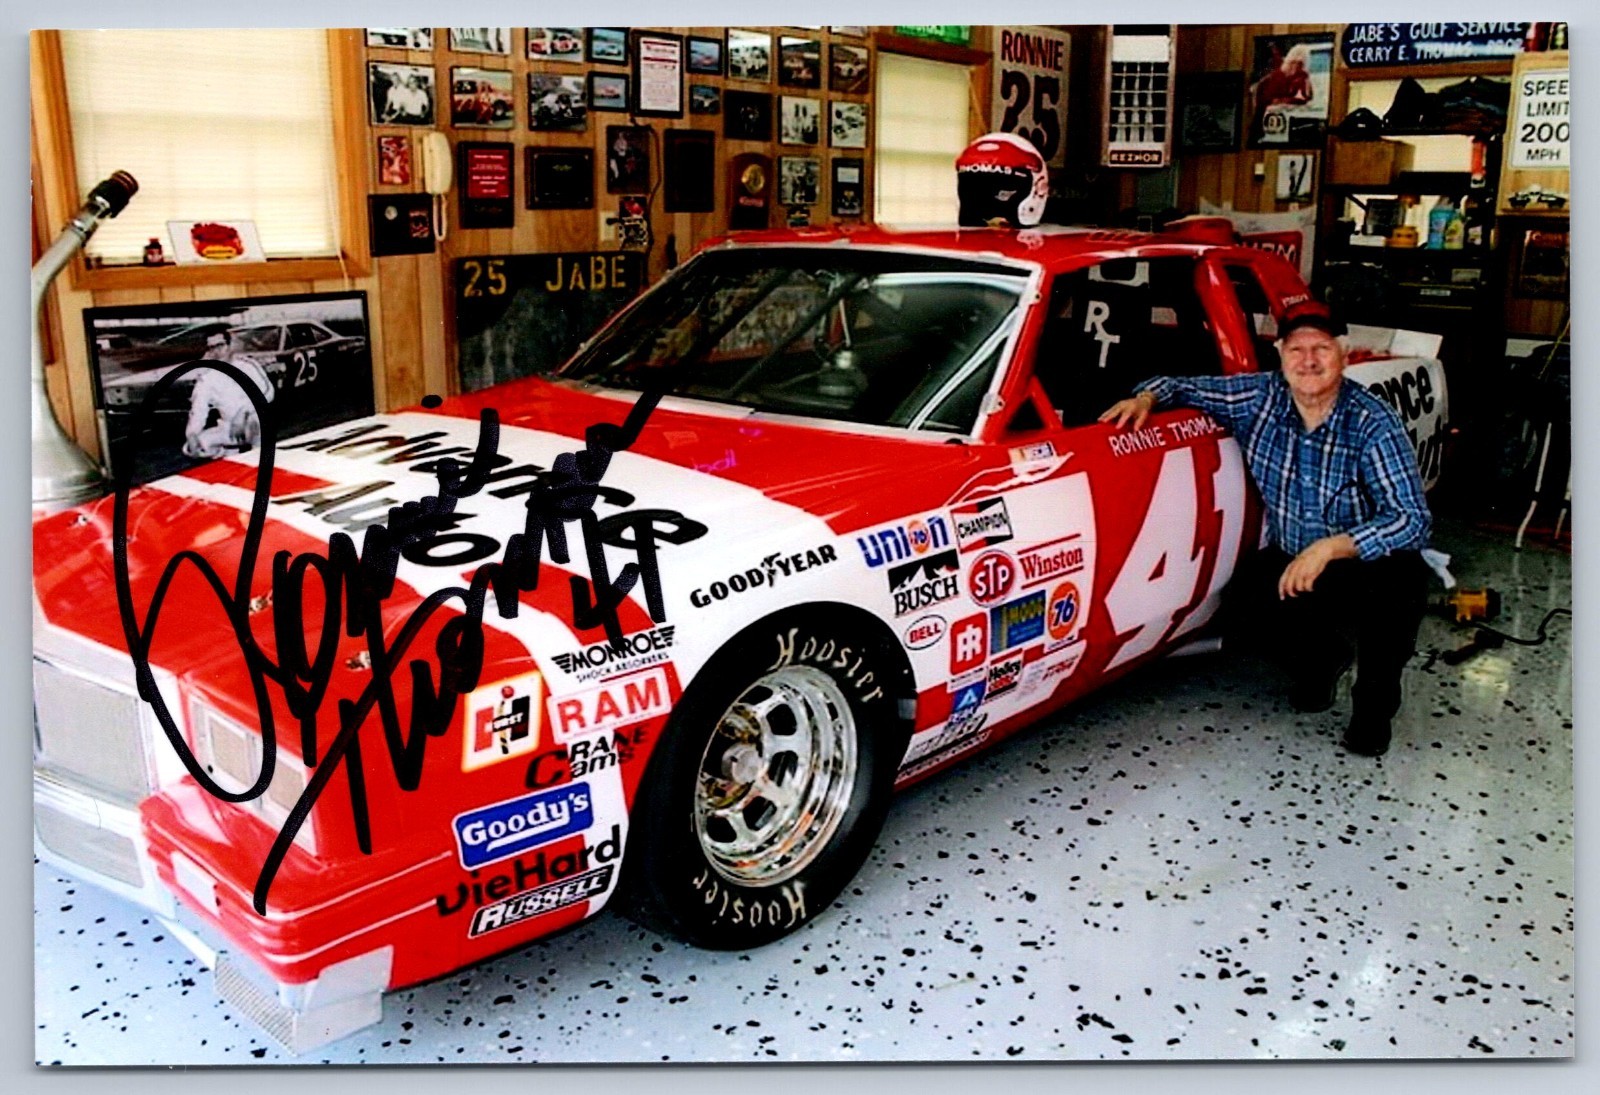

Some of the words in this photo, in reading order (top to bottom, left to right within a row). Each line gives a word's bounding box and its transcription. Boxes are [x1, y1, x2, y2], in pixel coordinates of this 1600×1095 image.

[1001, 29, 1064, 72] RONNIE
[1350, 23, 1400, 43] JABE'S
[1410, 22, 1449, 40] GULF
[1001, 68, 1060, 162] 25
[1527, 101, 1569, 117] LIMIT
[1521, 122, 1569, 143] 200
[1526, 149, 1560, 160] MPH
[464, 260, 506, 297] 25
[545, 254, 626, 292] JABE
[294, 350, 318, 387] 25
[1108, 426, 1166, 457] RONNIE
[1167, 416, 1224, 442] THOMA
[957, 512, 1008, 539] CHAMPION
[1020, 548, 1083, 582] Winston
[1103, 437, 1246, 672] 41
[690, 544, 837, 608] GOODYEAR
[893, 575, 960, 618] BUSCH
[974, 558, 1010, 598] STP
[1054, 593, 1076, 627] 76
[571, 630, 666, 672] MONROE
[910, 623, 942, 643] BELL
[576, 667, 612, 682] SHOCK
[615, 652, 670, 672] ABSORBERS
[767, 627, 884, 702] Hoosier
[558, 677, 661, 733] RAM
[462, 793, 590, 848] Goody's
[692, 868, 806, 928] Hoosier
